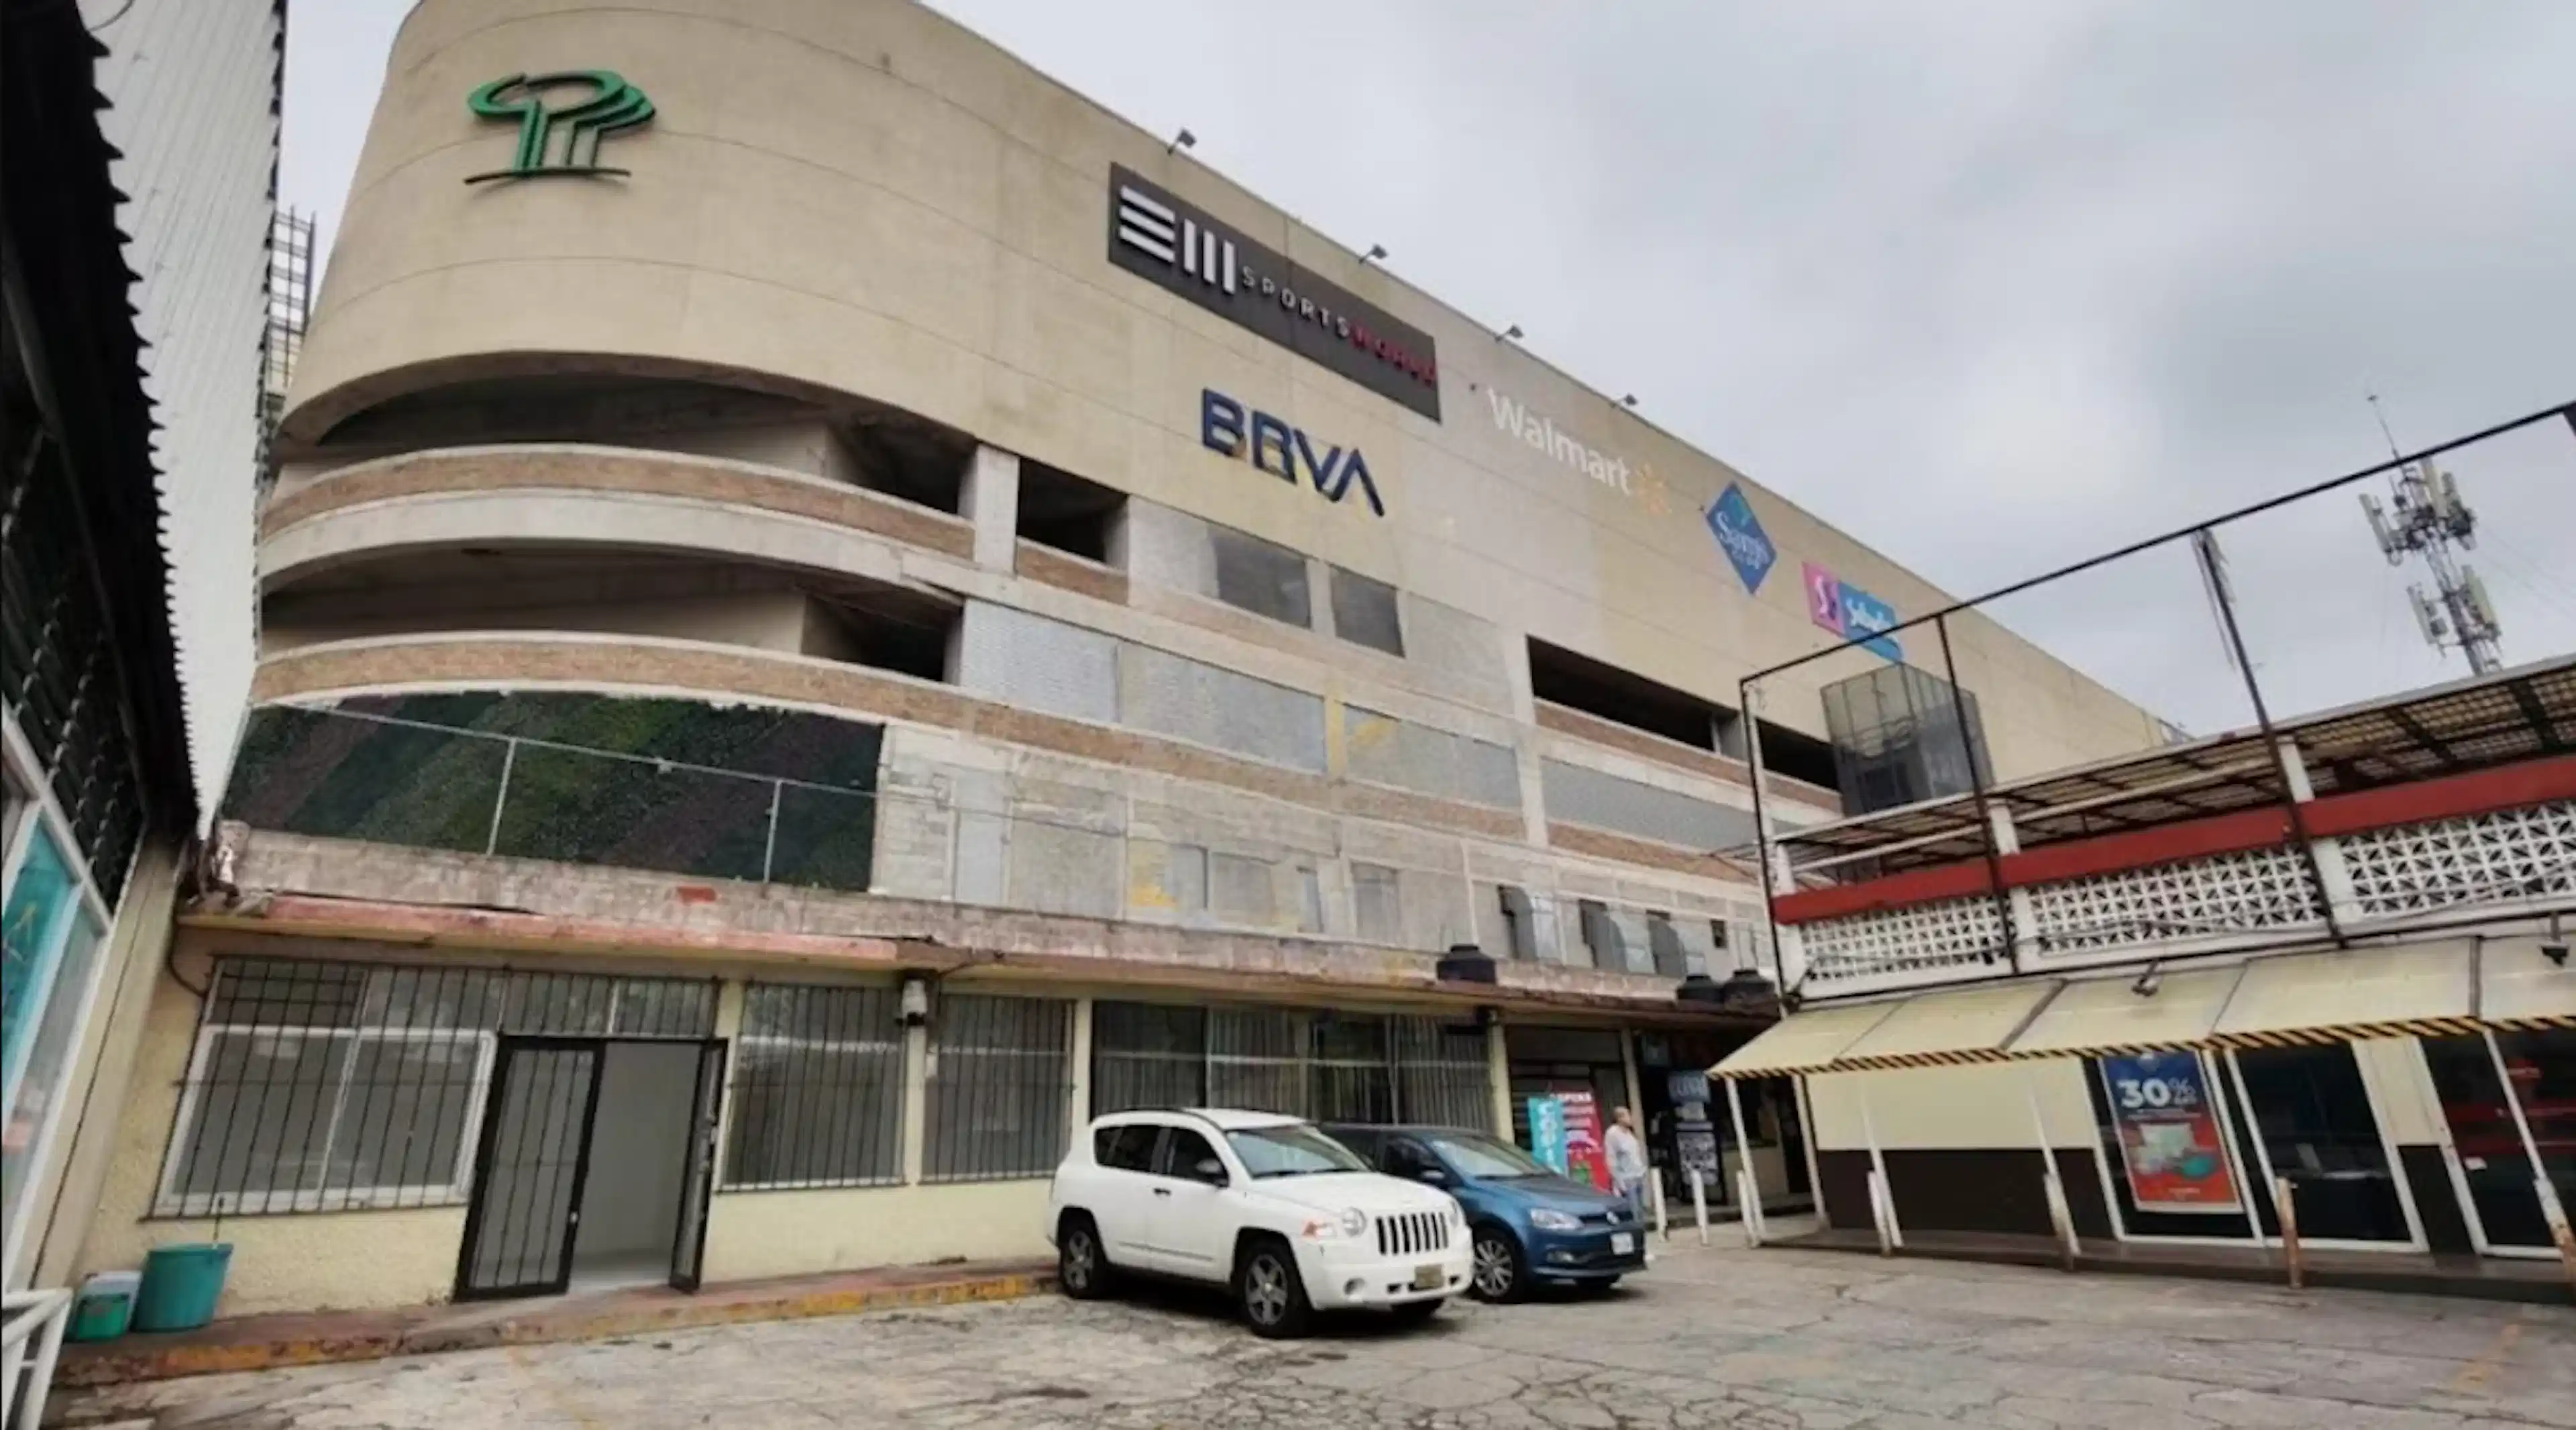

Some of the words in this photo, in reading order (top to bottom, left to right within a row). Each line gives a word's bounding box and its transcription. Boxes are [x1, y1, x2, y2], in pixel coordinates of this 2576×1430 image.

[1202, 387, 1385, 517] BBVA
[1487, 387, 1630, 496] Walmart
[2116, 1076, 2197, 1108] 30%
